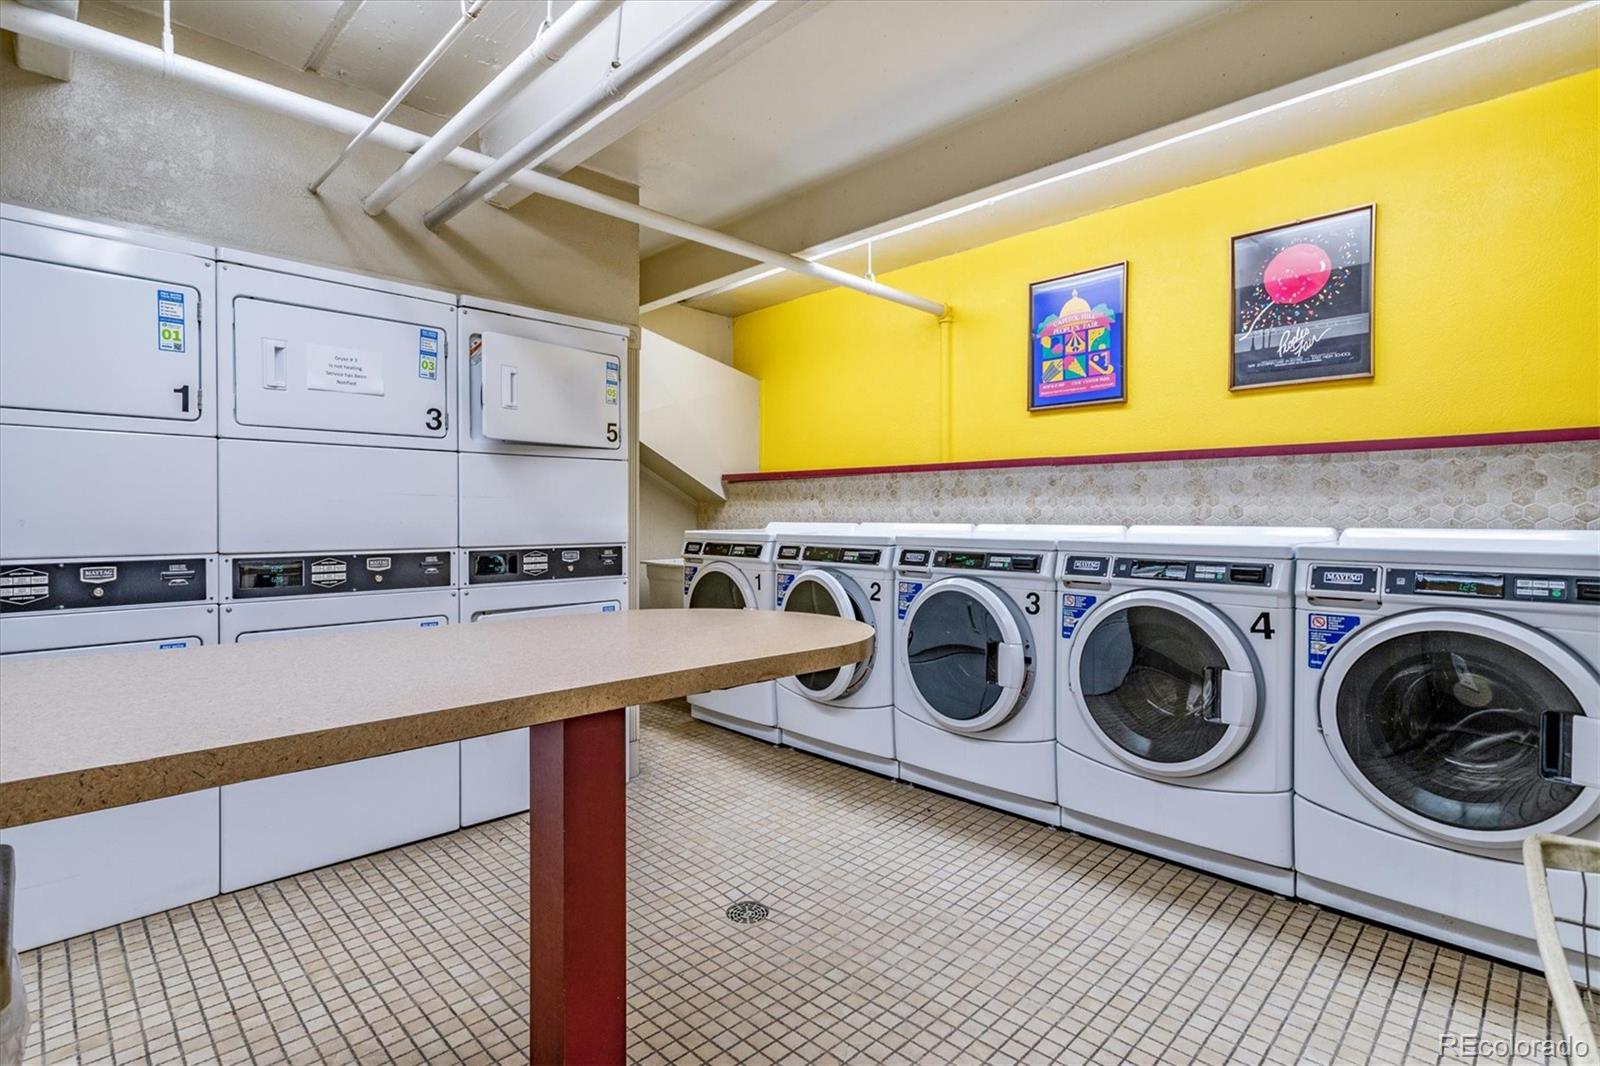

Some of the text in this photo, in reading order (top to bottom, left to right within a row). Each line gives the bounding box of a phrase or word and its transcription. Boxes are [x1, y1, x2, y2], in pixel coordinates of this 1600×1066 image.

[1083, 321, 1099, 330] FAIR
[162, 329, 182, 342] 01
[421, 360, 435, 371] 03
[174, 385, 189, 412] 1
[426, 408, 442, 431] 3
[606, 423, 618, 442] 5
[755, 574, 761, 590] 1
[870, 582, 881, 602] 2
[1025, 592, 1040, 615] 3
[1250, 612, 1275, 640] 4
